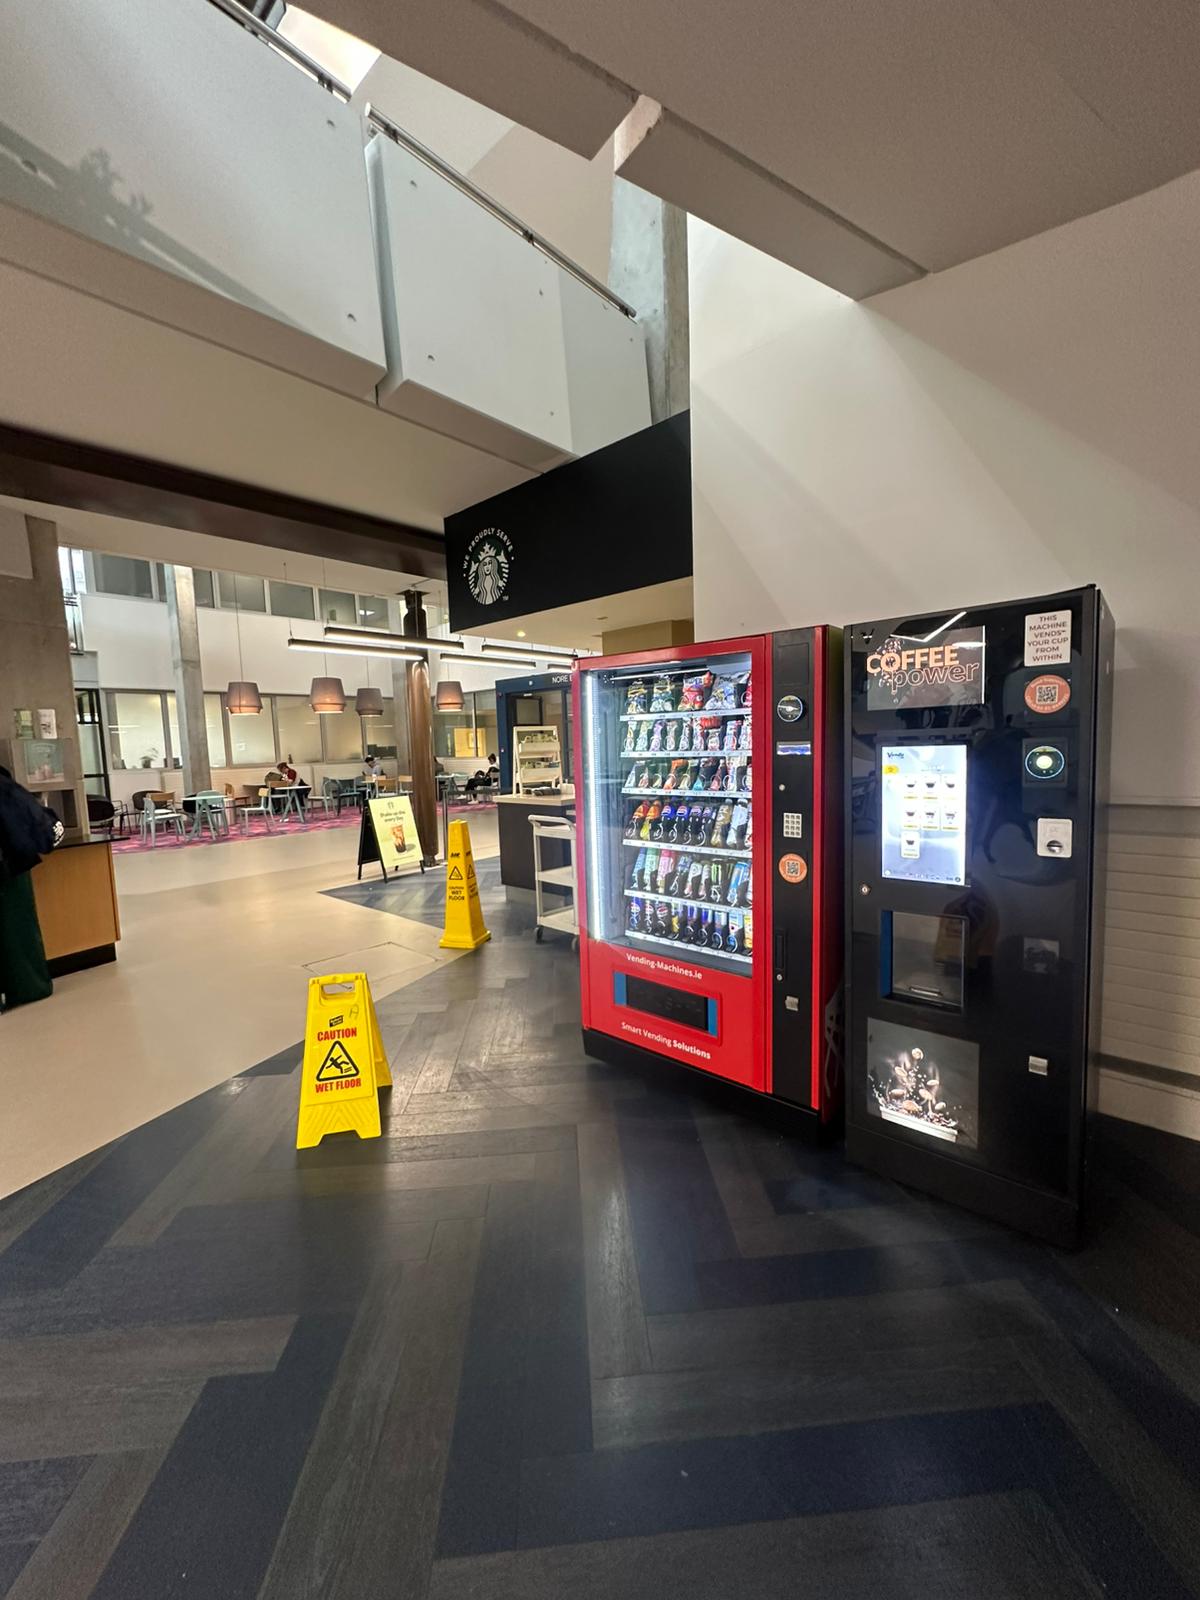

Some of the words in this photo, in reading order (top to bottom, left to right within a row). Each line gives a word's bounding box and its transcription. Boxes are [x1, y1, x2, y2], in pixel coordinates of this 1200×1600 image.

[463, 554, 470, 569] WE
[468, 528, 495, 552] PROUDLY
[496, 528, 513, 552] SERVE
[1039, 614, 1057, 622] THIS
[1029, 621, 1068, 631] MACHINE
[1027, 639, 1050, 647] YOUR
[1035, 646, 1060, 654] FROM
[866, 645, 960, 674] COFFEE
[1032, 653, 1063, 662] WITHIN
[552, 674, 569, 684] NORE
[891, 662, 980, 696] power
[626, 953, 703, 979] Vending-Machines.ie
[317, 1027, 357, 1041] CAUTION
[621, 1022, 642, 1036] Smart
[642, 1029, 672, 1048] Vending
[672, 1039, 711, 1060] Solutions
[315, 1082, 334, 1093] WET
[335, 1078, 361, 1090] FLOOR
